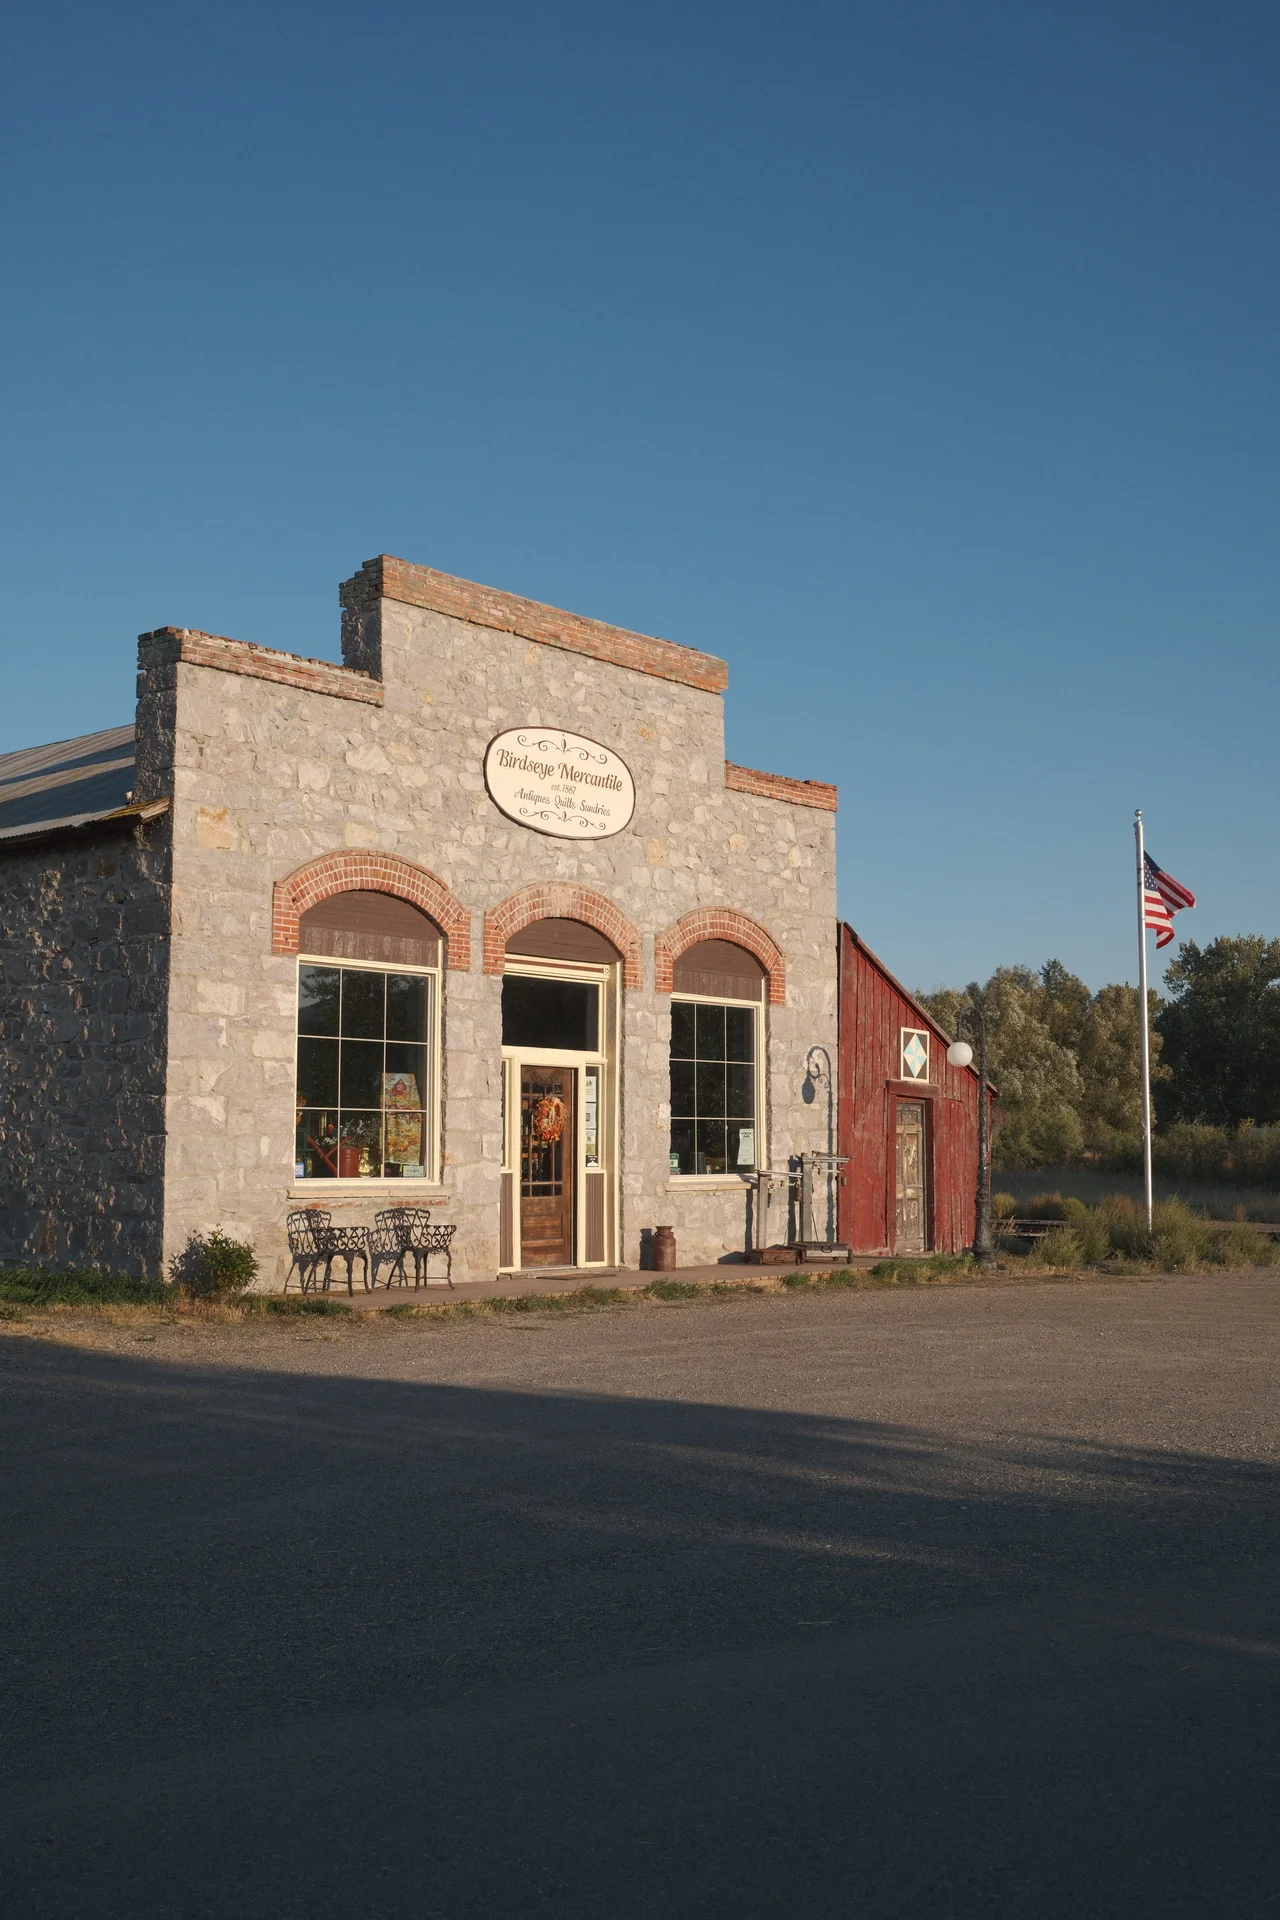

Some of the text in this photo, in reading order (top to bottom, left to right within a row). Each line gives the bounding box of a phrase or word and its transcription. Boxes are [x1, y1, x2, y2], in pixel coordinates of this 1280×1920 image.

[496, 748, 623, 792] Birdseye Mercantile
[513, 787, 611, 817] Antiques Quilts Sundries
